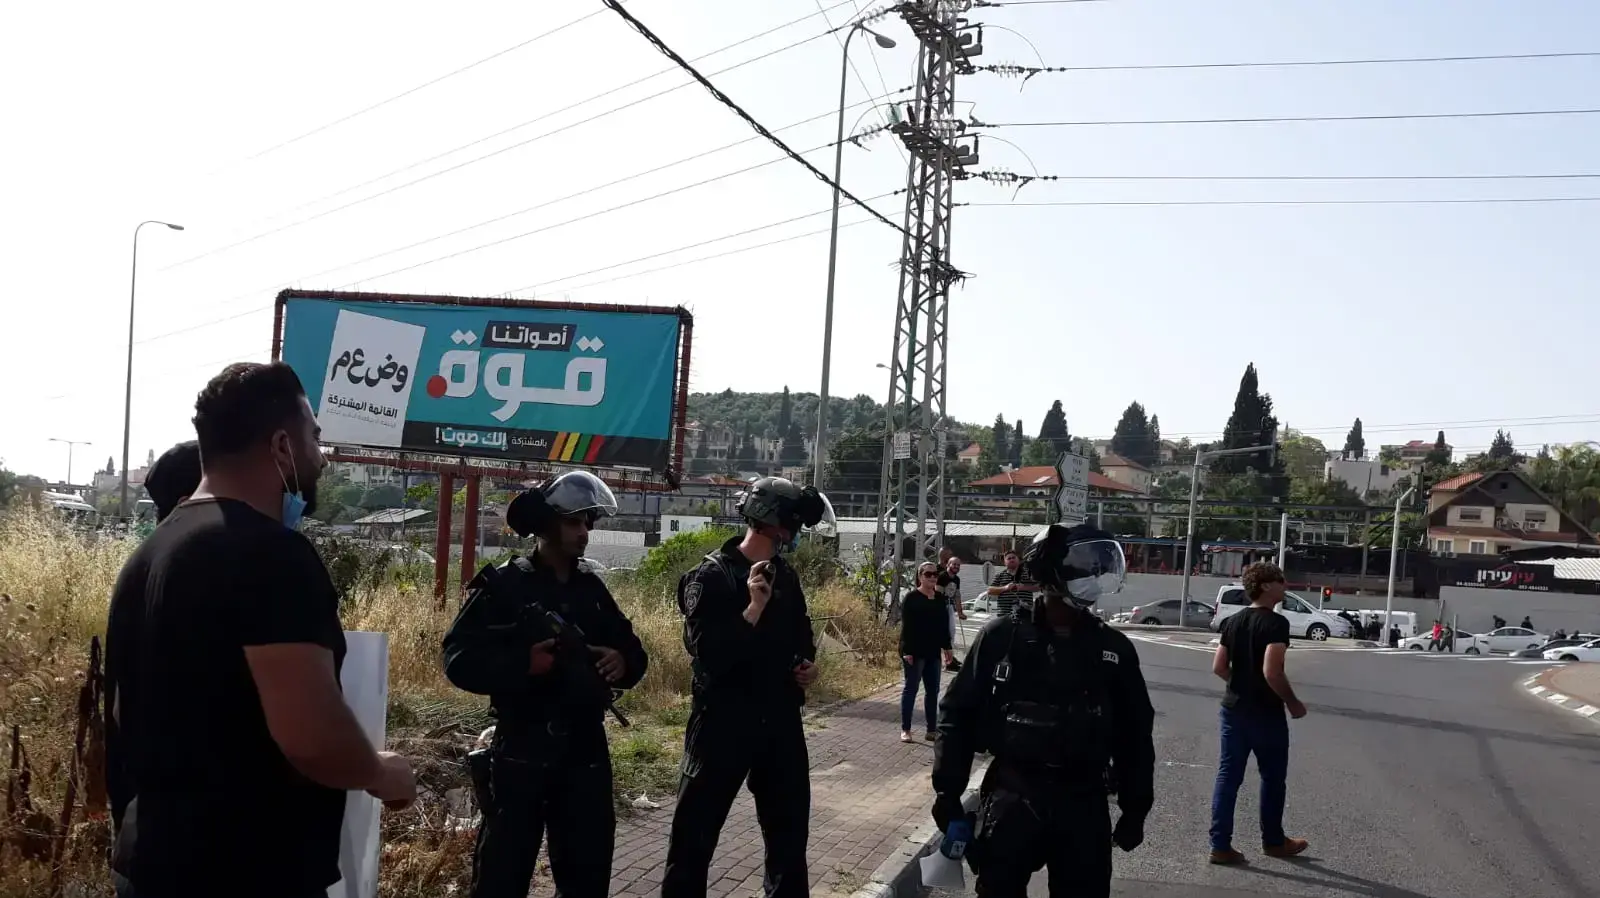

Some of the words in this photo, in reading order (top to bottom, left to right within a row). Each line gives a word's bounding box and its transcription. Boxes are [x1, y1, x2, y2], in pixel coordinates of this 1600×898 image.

[491, 325, 568, 349] أصواتنا
[327, 393, 367, 411] المشتركة
[368, 403, 398, 419] القائمة
[511, 436, 548, 448] بالمشتركة
